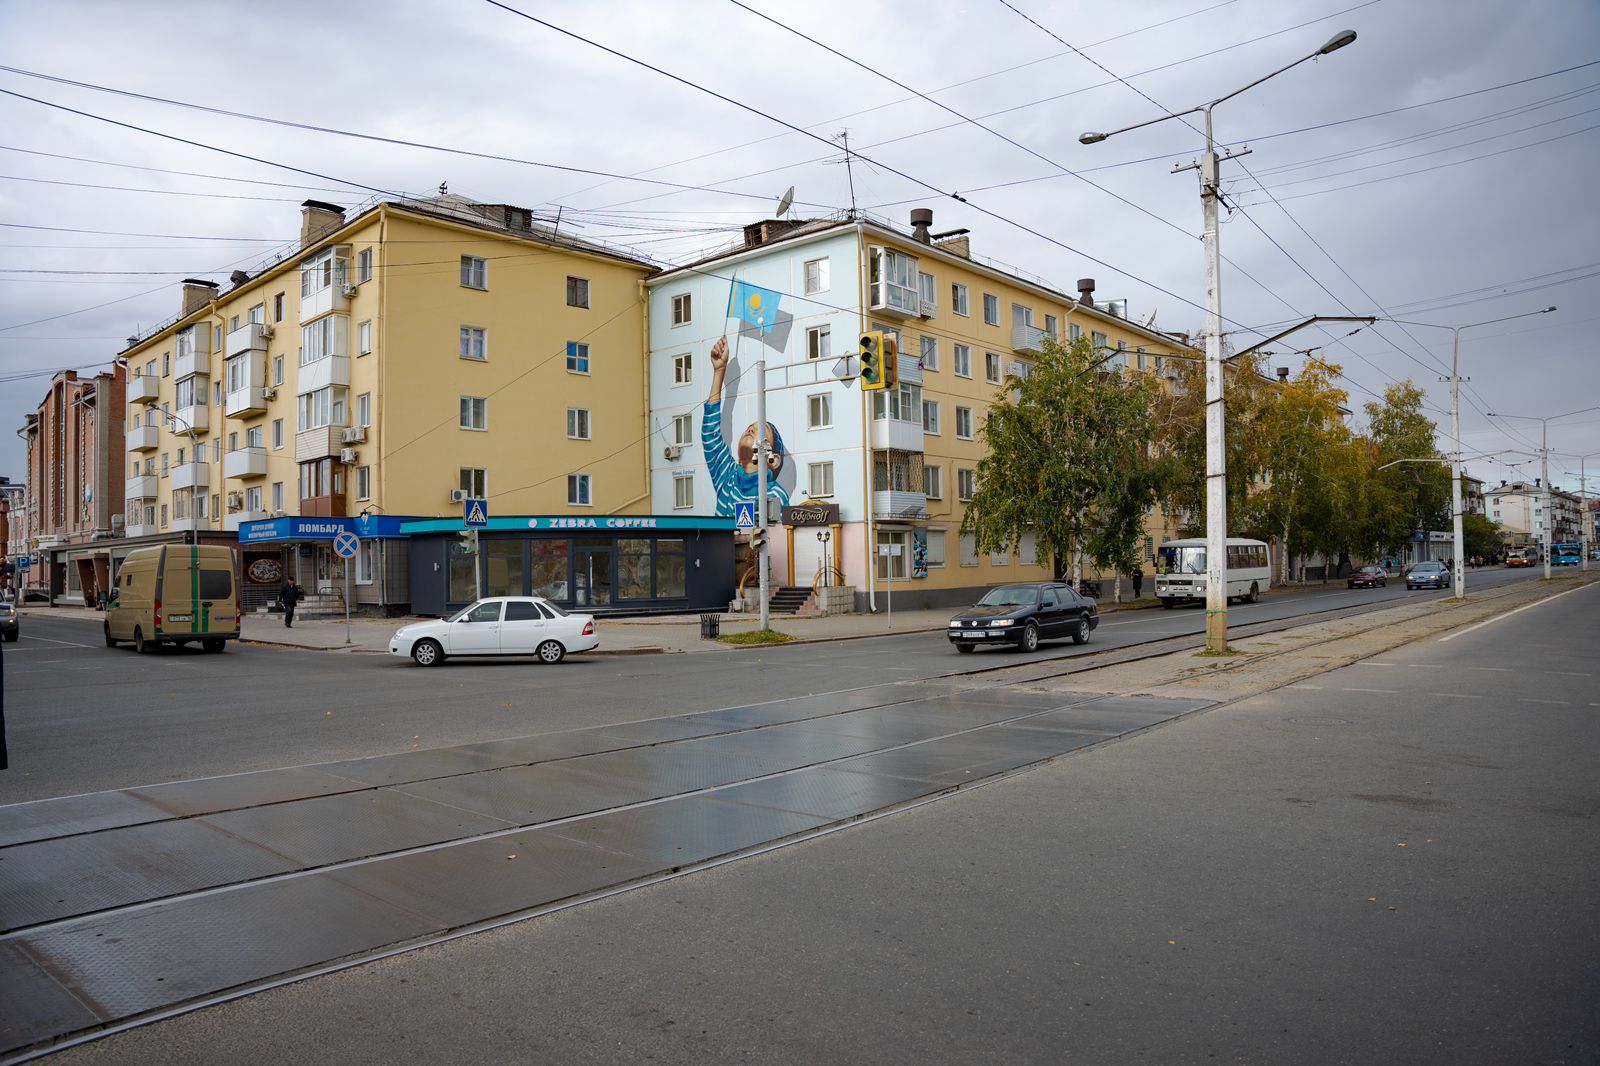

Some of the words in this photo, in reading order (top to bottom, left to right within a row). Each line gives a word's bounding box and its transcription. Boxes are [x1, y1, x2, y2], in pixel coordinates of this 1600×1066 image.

[298, 523, 345, 533] ЛОМБАРД
[549, 518, 597, 528] ZEBRA
[606, 518, 656, 528] COFFEE
